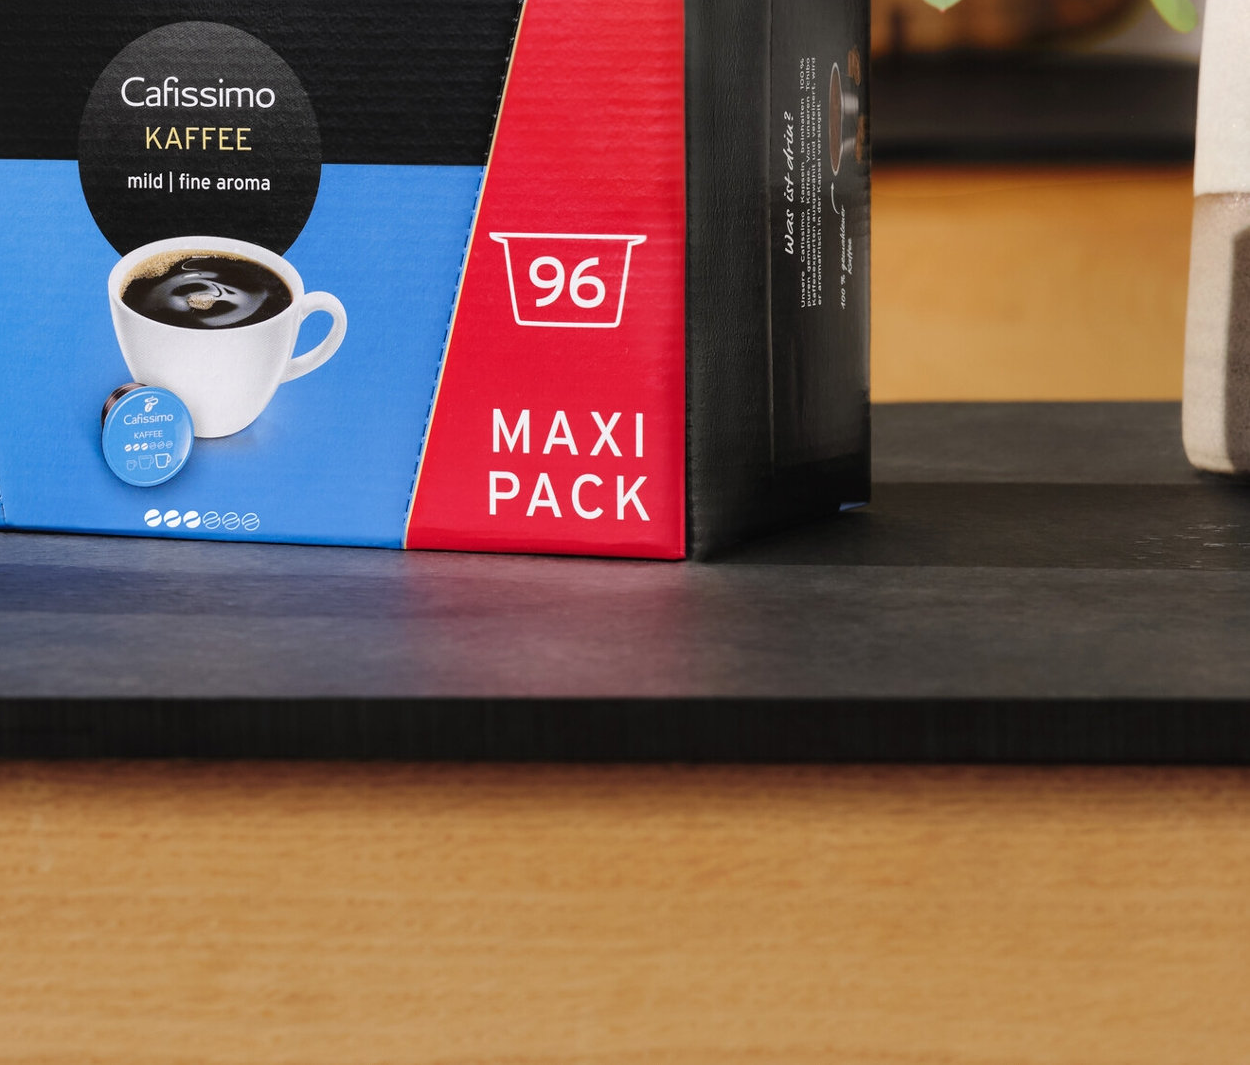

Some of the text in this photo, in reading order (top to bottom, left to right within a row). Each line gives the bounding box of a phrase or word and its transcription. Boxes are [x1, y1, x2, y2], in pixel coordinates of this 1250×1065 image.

[120, 76, 276, 109] Cafissimo
[145, 126, 252, 152] KAFFEE
[127, 172, 163, 190] mild
[178, 172, 211, 190] fine
[216, 175, 271, 191] aroma
[783, 111, 794, 254] Was ist drin?
[528, 255, 606, 309] 96
[123, 413, 174, 425] Cafissimo
[133, 430, 164, 440] KAFFEE
[492, 407, 644, 458] MAXI
[488, 470, 651, 521] PACK
